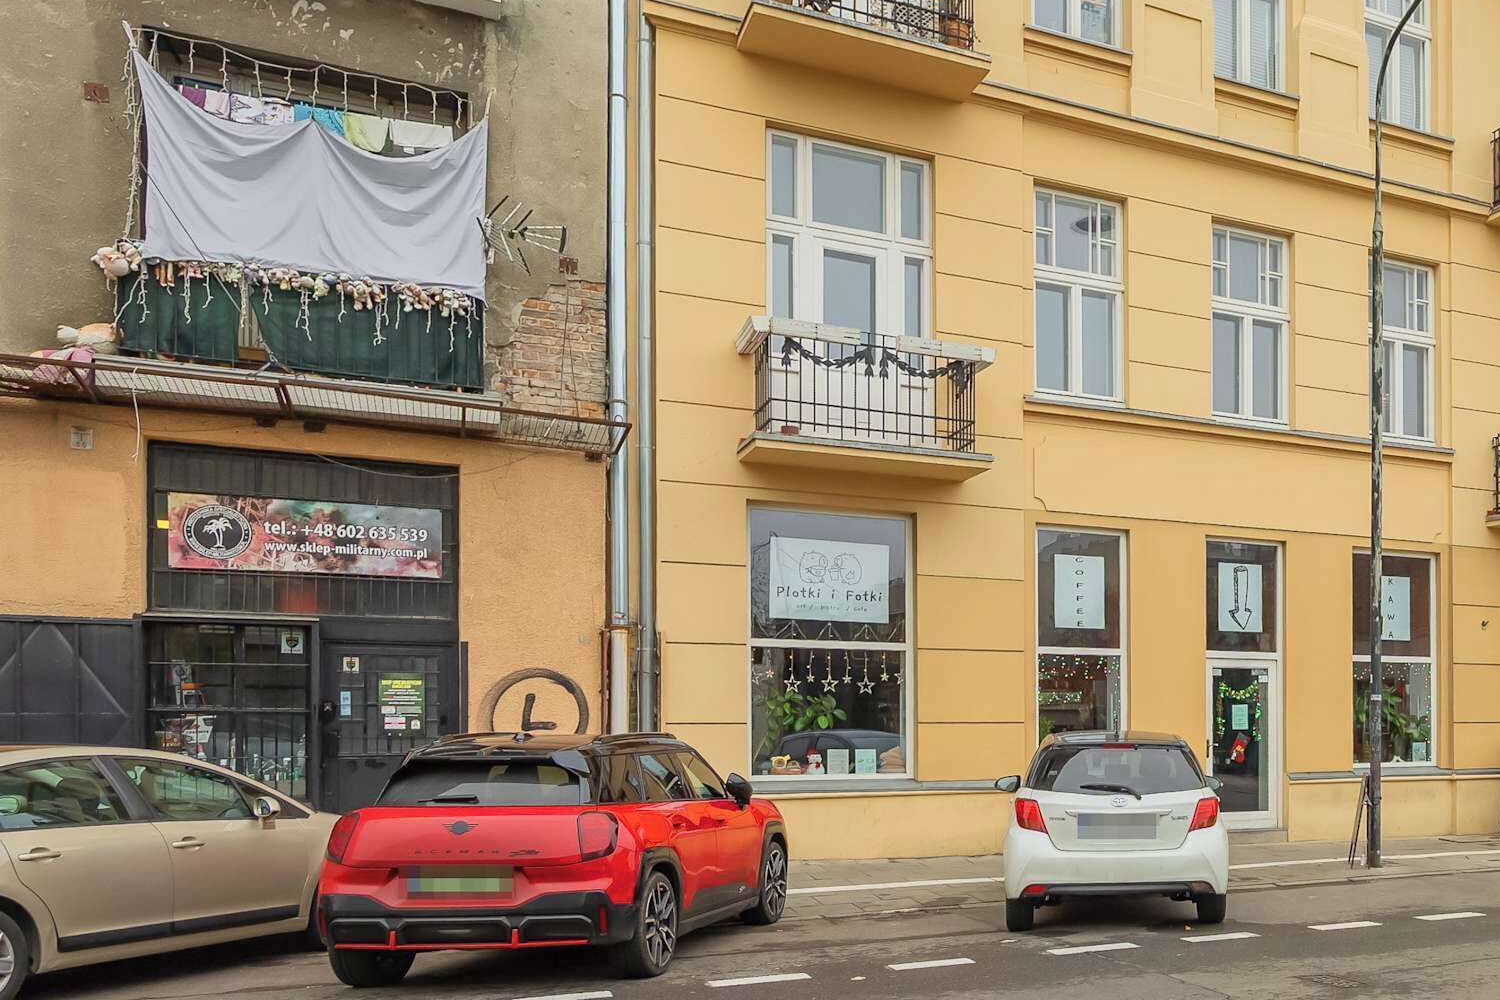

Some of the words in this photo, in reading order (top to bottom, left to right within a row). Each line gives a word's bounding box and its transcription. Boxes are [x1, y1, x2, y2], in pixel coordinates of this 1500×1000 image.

[263, 521, 297, 536] tel.:
[301, 522, 332, 538] +48
[336, 524, 364, 539] 602
[368, 526, 396, 541] 635
[400, 527, 428, 543] 539
[263, 542, 428, 560] www.sklep-militarny.com.pl
[831, 589, 836, 599] i
[846, 591, 882, 602] Fotki
[1075, 557, 1084, 627] COFFEE
[1387, 577, 1395, 638] KAWA
